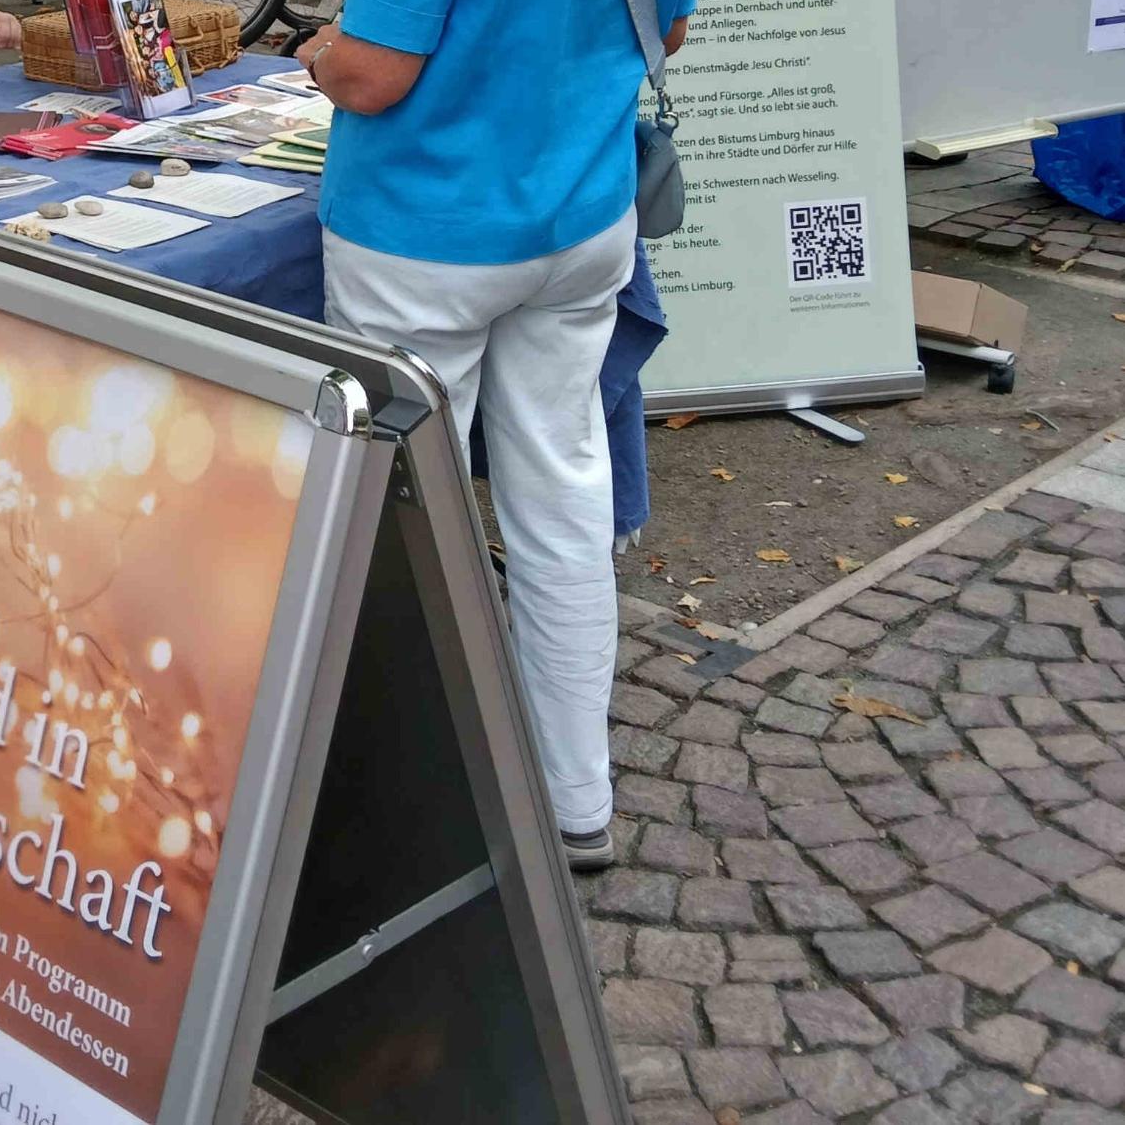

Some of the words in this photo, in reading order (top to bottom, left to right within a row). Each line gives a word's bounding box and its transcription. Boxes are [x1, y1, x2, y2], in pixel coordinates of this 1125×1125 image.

[724, 3, 734, 14] in
[736, 0, 784, 14] Dernbach
[688, 19, 708, 31] und
[710, 17, 758, 30] Anliegen.
[717, 32, 727, 43] in
[728, 31, 745, 43] der
[747, 27, 798, 43] Nachfolge
[799, 28, 818, 38] von
[819, 25, 847, 37] Jesus
[683, 60, 750, 75] Dienstmägde
[751, 58, 773, 71] Jesu
[698, 90, 719, 103] und
[720, 88, 766, 104] Fürsorge.
[796, 83, 809, 96] ist
[810, 82, 837, 97] groß,
[697, 107, 718, 120] sagt
[720, 105, 737, 117] sie.
[738, 103, 759, 115] Und
[761, 104, 773, 114] so
[775, 100, 795, 112] lebt
[796, 99, 811, 110] sie
[812, 97, 839, 110] auch.
[698, 134, 717, 147] des
[718, 132, 757, 146] Bistums
[759, 129, 801, 144] Limburg
[802, 127, 836, 140] hinaus
[694, 148, 704, 161] in
[706, 146, 726, 160] ihre
[727, 144, 761, 159] Städte
[762, 143, 781, 156] und
[783, 141, 815, 155] Dörfer
[817, 142, 833, 153] zur
[834, 139, 859, 152] Hilfe
[683, 178, 702, 190] drei
[703, 175, 761, 190] Schwestern
[762, 174, 787, 185] nach
[788, 170, 841, 184] Wesseling.
[704, 193, 717, 205] ist
[687, 223, 704, 235] der
[673, 239, 688, 250] bis
[689, 237, 722, 249] heute.
[691, 280, 736, 292] Limburg.
[25, 690, 90, 790] in
[13, 934, 132, 1028] Programm
[0, 978, 131, 1079] Abendessen
